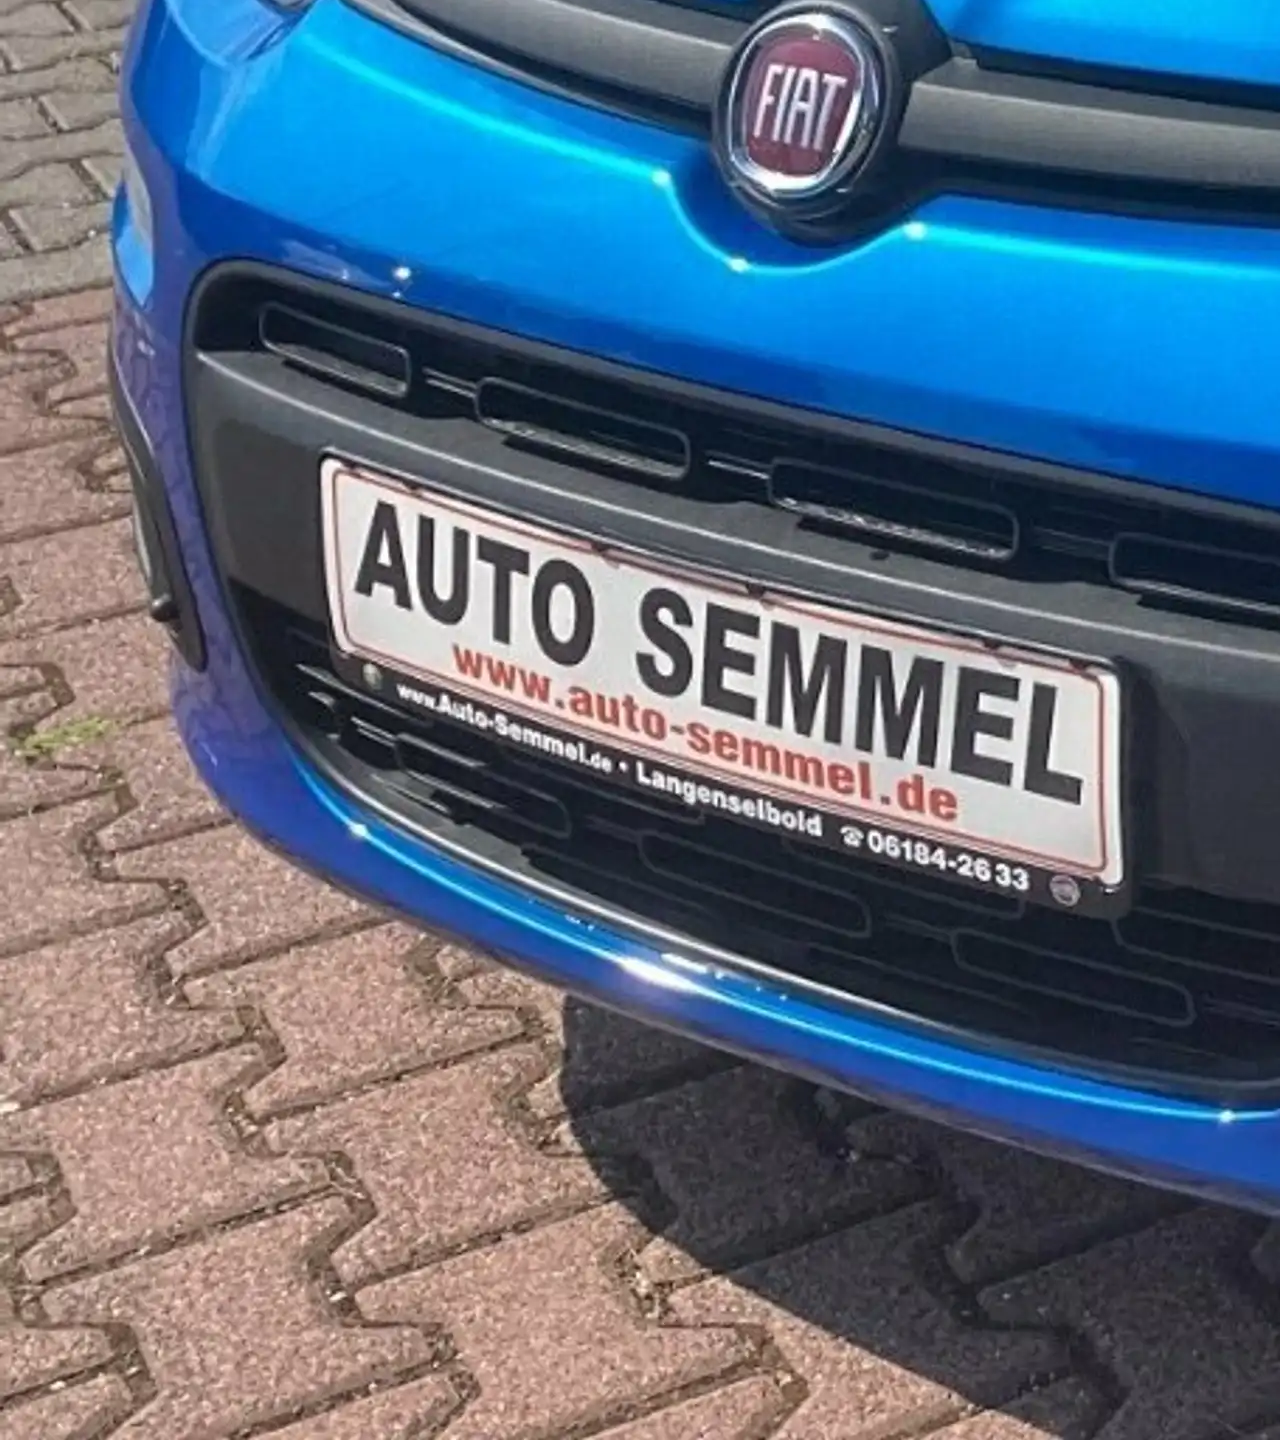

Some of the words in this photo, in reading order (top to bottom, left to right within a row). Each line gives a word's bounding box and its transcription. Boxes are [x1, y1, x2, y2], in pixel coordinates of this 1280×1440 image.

[753, 63, 848, 151] FIAT
[354, 499, 595, 666] AUTO
[635, 586, 1083, 806] SEMMEL
[452, 643, 959, 822] www.auto-semmel.de
[396, 683, 613, 773] www.Auto-Semmel.de
[635, 762, 823, 838] Langenselbold
